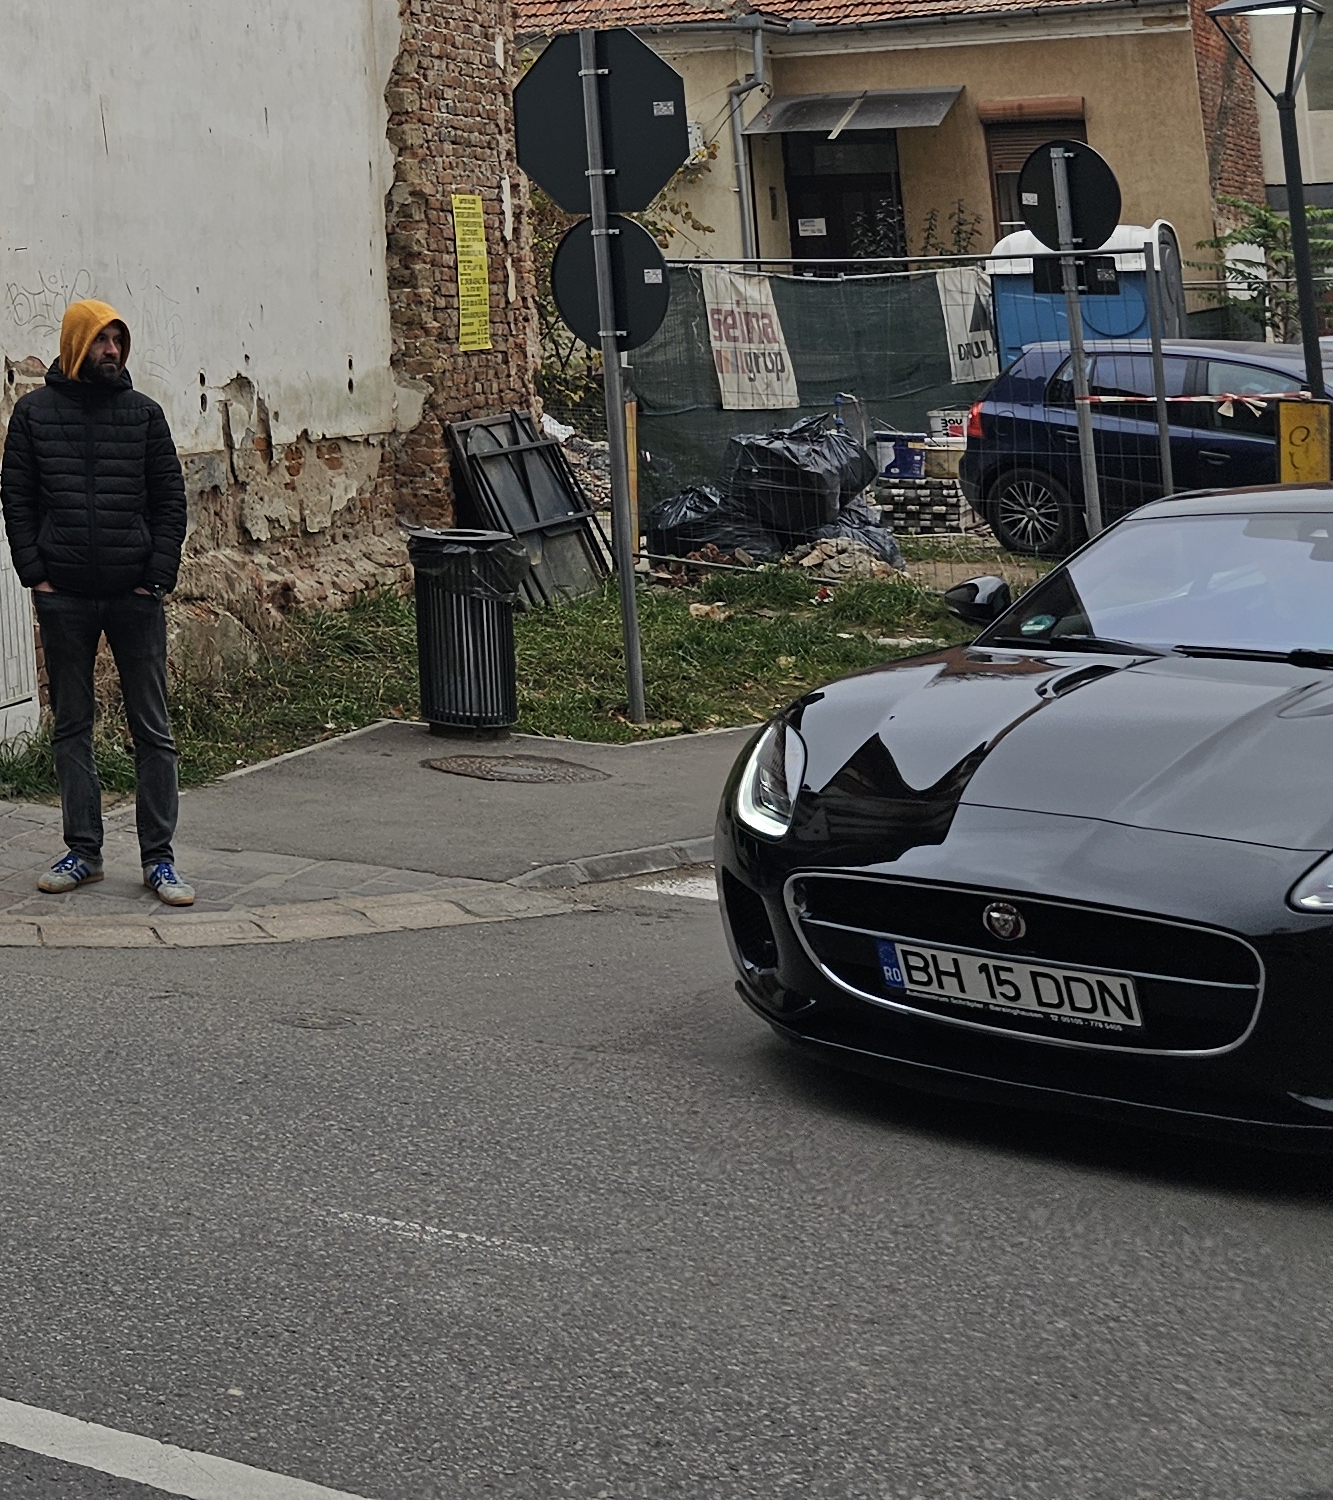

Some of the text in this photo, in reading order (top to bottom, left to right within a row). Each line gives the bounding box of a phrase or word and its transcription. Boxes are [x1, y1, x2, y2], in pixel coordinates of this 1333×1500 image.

[744, 350, 786, 383] grup
[883, 966, 902, 983] RO
[900, 949, 1135, 1021] BH 15 DDN
